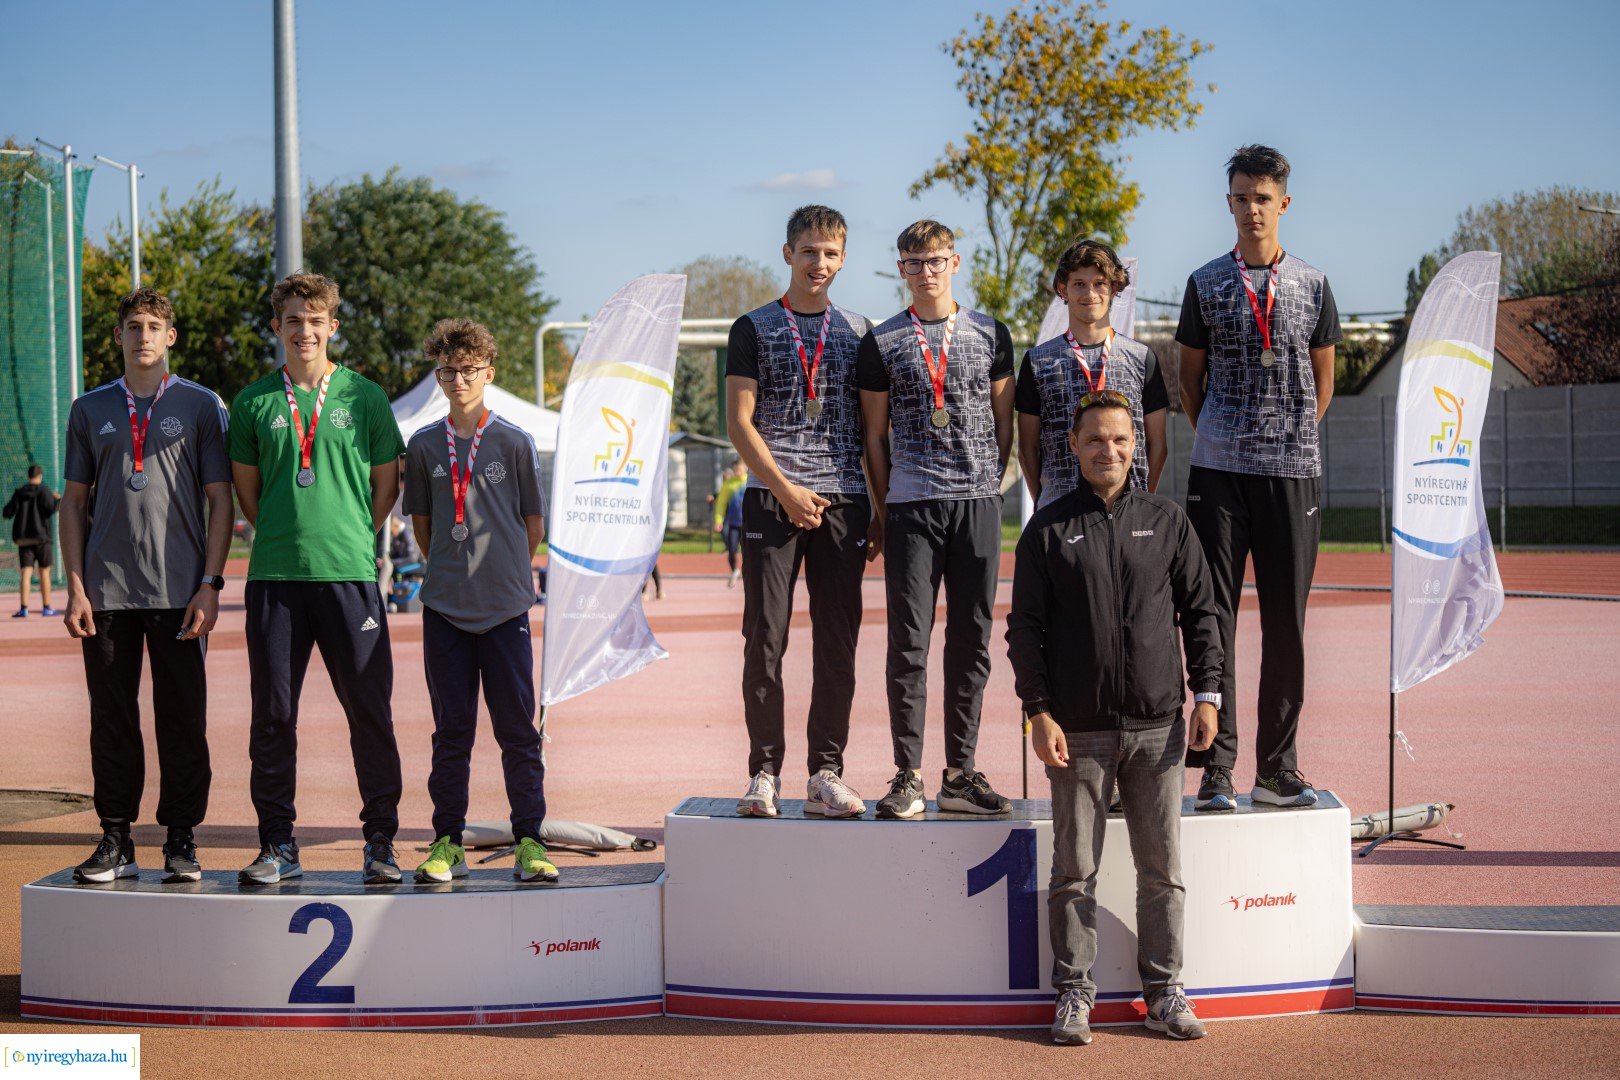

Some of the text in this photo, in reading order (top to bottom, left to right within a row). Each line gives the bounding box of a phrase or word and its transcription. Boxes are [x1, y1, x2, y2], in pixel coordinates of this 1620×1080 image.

[566, 511, 651, 525] SPORTCENTRUM
[575, 494, 642, 510] NYÍREGYHÁZI
[967, 829, 1040, 989] 1
[288, 902, 355, 1004] 2
